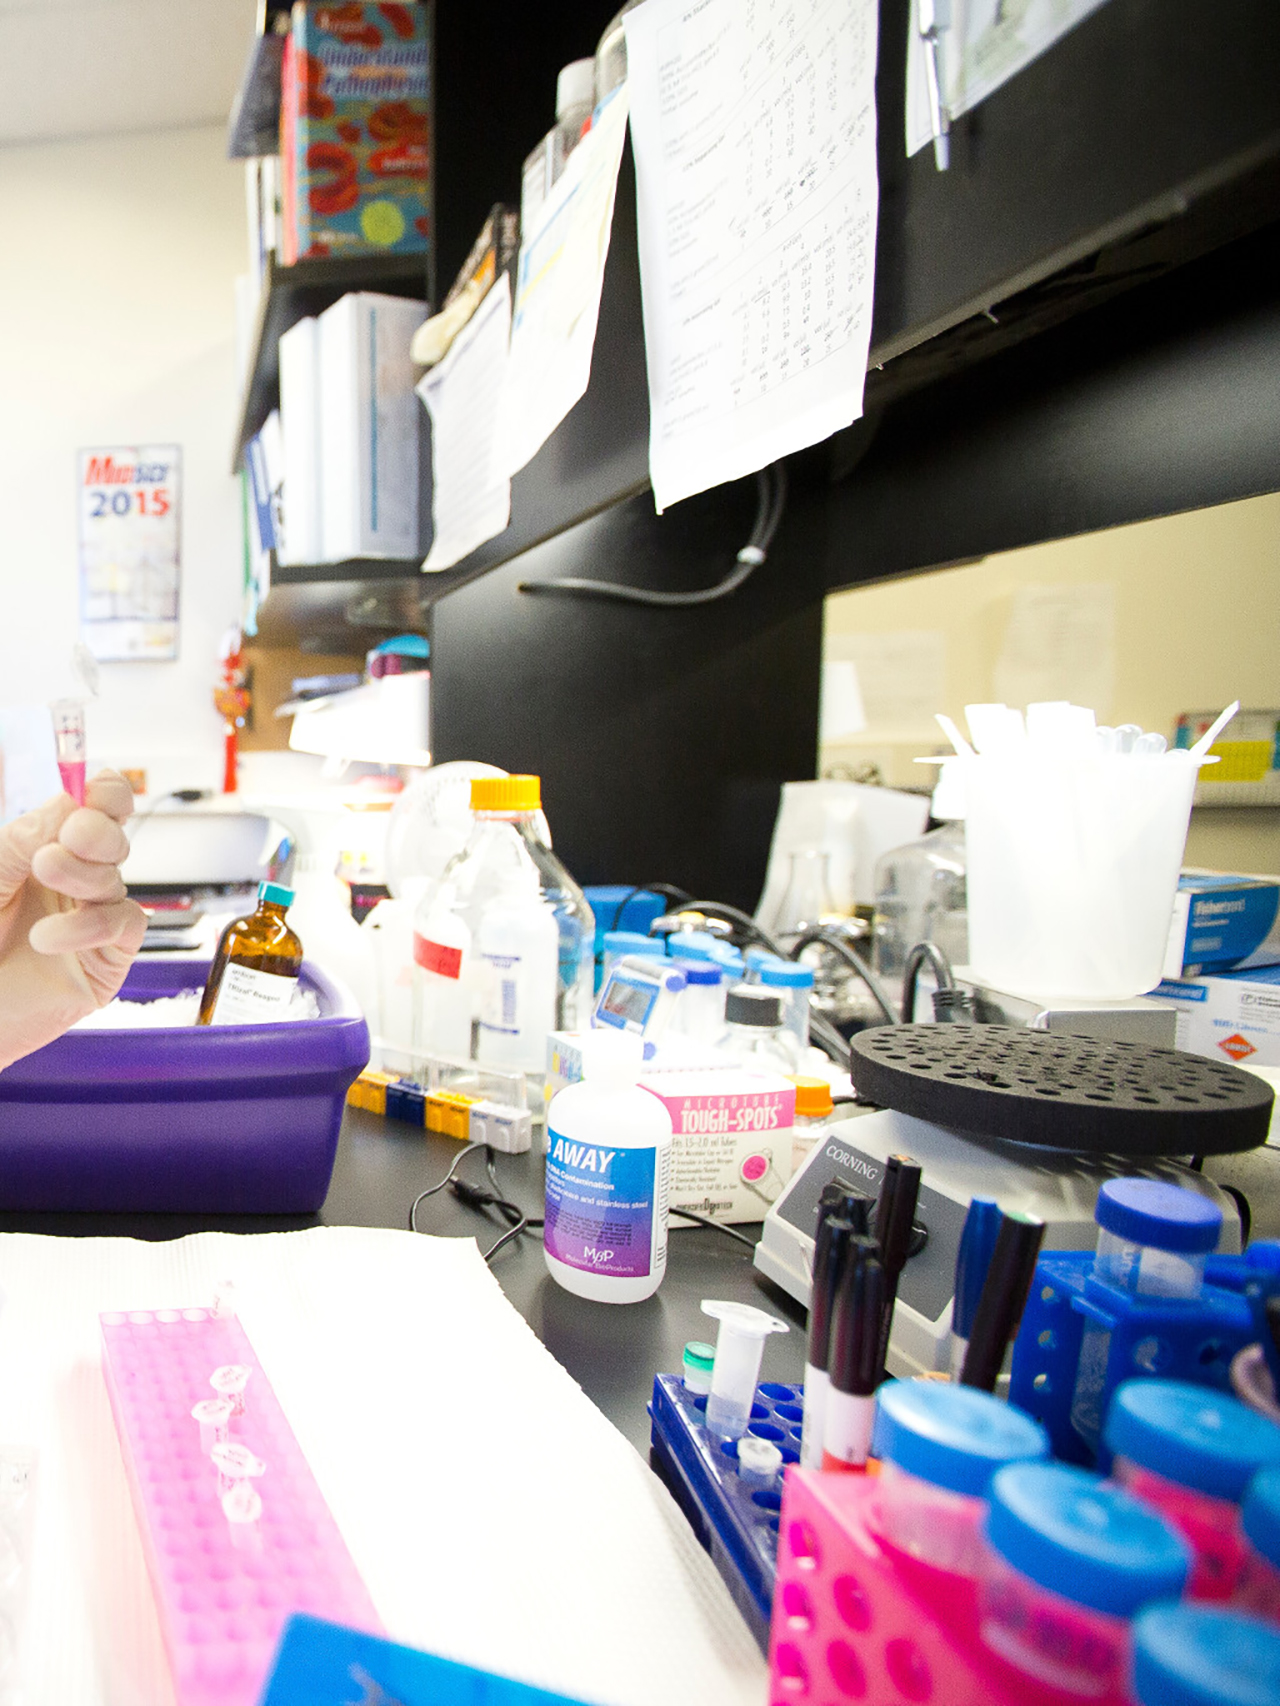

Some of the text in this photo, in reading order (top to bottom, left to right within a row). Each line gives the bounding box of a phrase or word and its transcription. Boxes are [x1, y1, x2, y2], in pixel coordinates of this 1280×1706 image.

[90, 488, 170, 518] 2015
[680, 1105, 778, 1133] TOUGH-SPOTS
[553, 1138, 616, 1174] AWAY
[826, 1144, 880, 1181] CORNING
[561, 1170, 615, 1190] Contamination
[596, 1199, 630, 1209] stainless
[631, 1201, 648, 1209] steel
